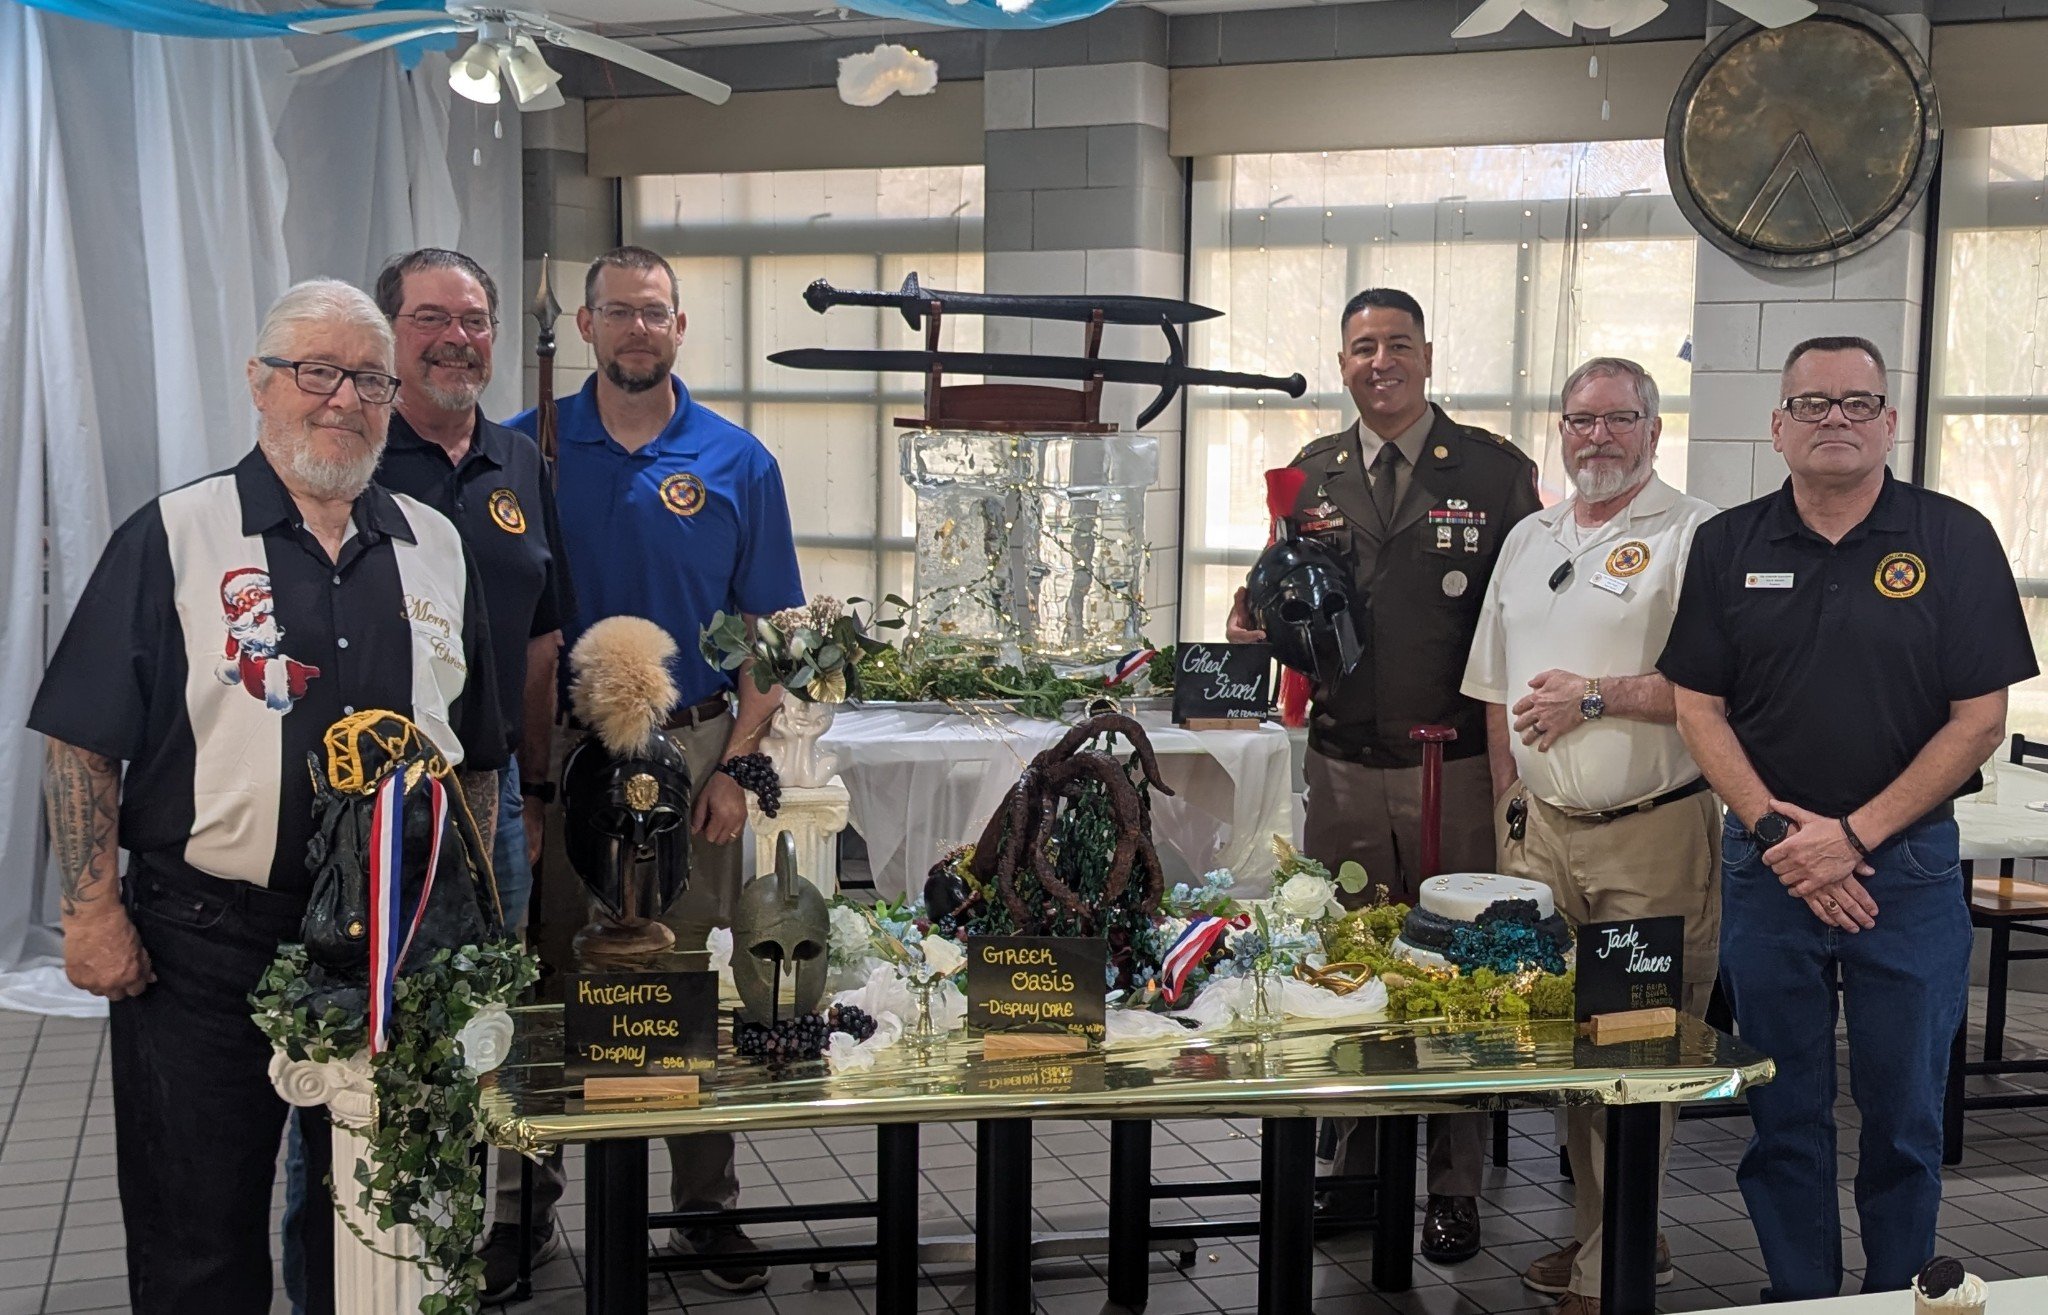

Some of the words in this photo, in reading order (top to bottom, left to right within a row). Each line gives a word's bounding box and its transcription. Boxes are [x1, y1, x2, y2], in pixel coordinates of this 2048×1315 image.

[400, 594, 451, 638] Merry
[982, 945, 1057, 966] GREEK
[1595, 924, 1639, 958] Jade
